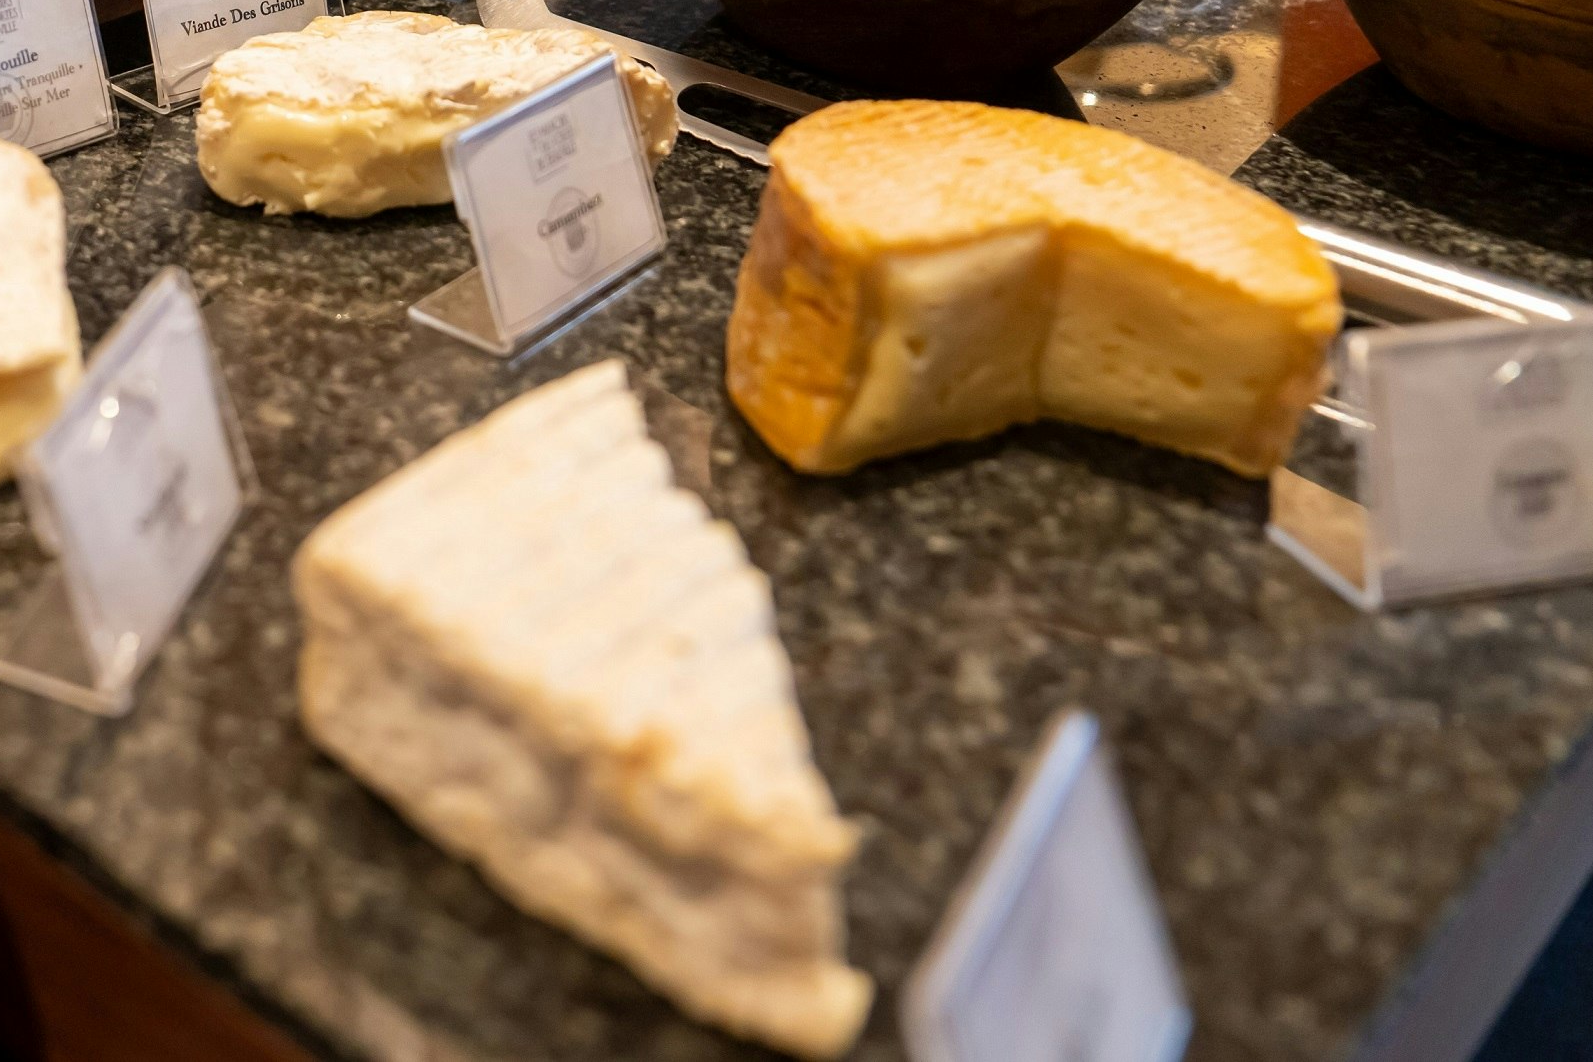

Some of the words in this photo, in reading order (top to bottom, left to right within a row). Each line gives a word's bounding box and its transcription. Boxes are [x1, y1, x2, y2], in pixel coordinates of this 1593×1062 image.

[181, 14, 227, 36] Viande
[229, 8, 257, 24] Des
[14, 62, 75, 91] Tranquille
[21, 94, 43, 110] Sur
[46, 87, 70, 103] Mer
